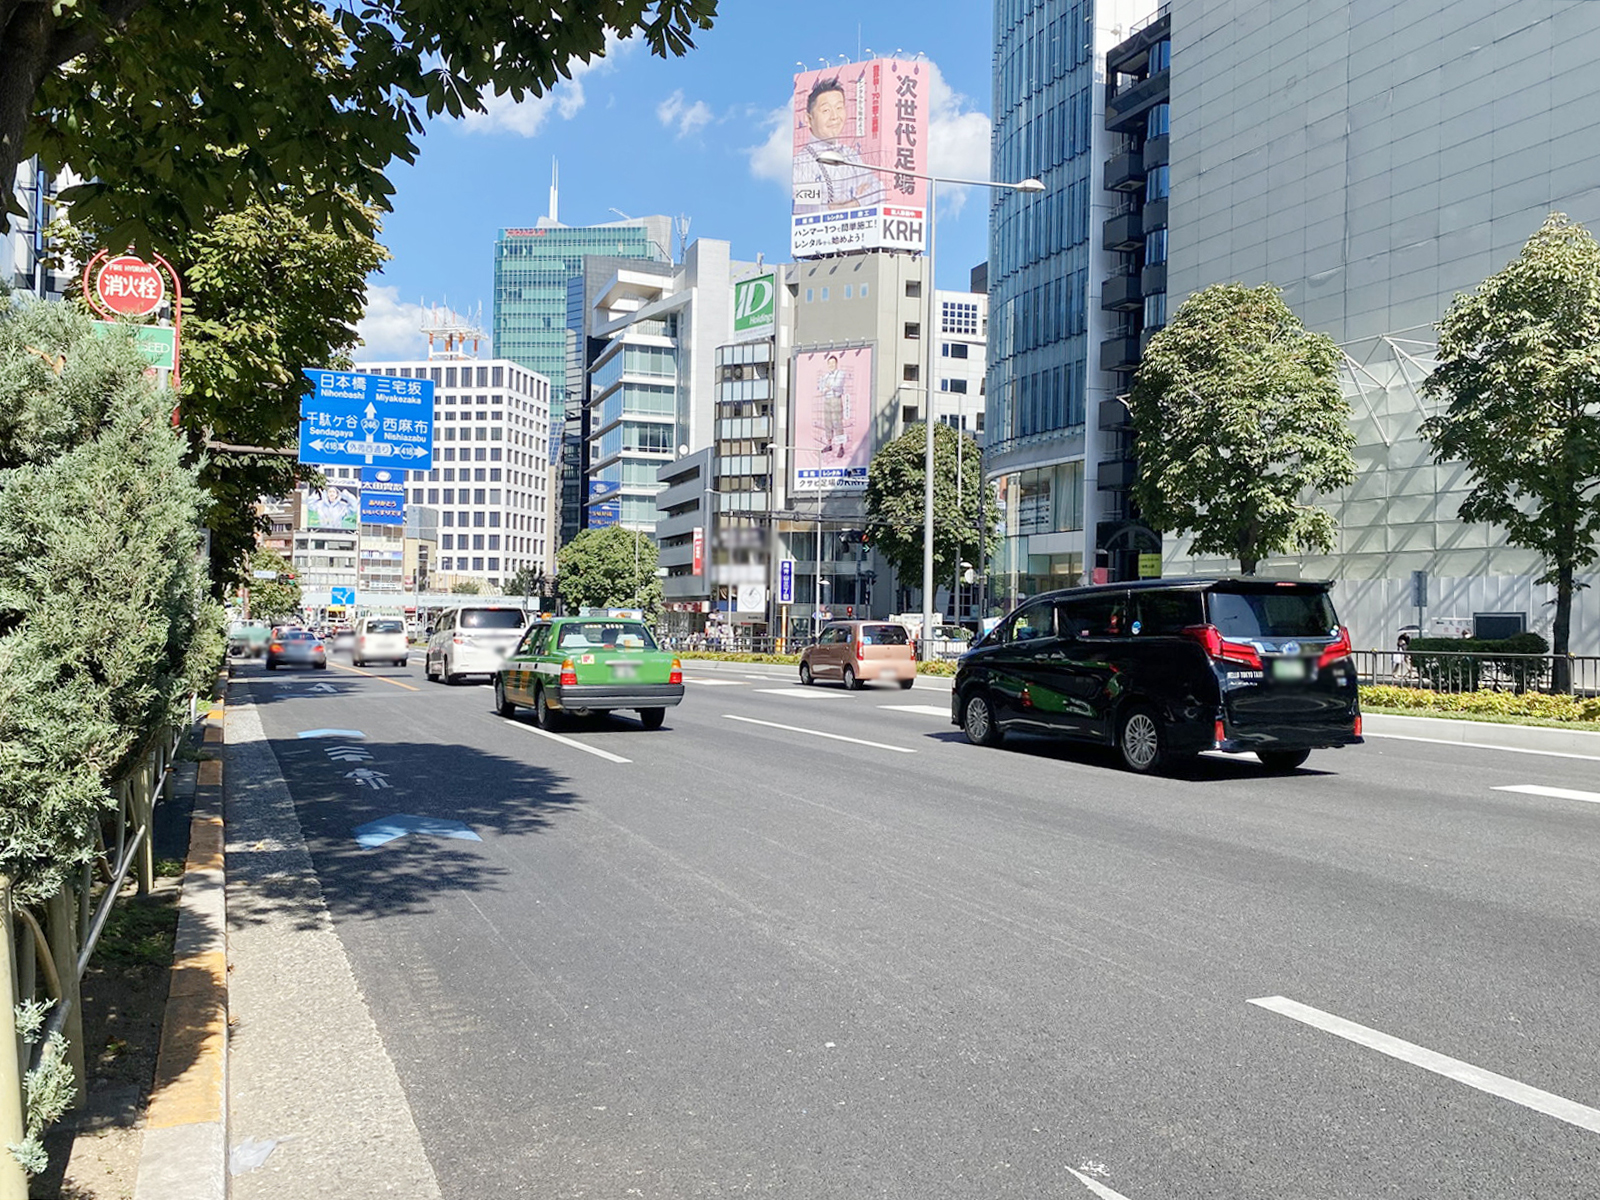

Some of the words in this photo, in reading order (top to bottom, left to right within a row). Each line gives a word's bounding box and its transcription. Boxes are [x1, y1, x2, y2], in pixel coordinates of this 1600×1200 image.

[894, 75, 918, 195] 次世代足場
[796, 189, 820, 199] KRH
[826, 213, 845, 222] レンタル
[883, 219, 922, 242] KRH
[104, 274, 158, 299] 消火栓
[736, 280, 773, 320] ID
[321, 373, 367, 391] 日本橋
[376, 379, 422, 396] 三宅坂
[321, 388, 365, 399] Nihonbashi
[376, 393, 422, 405] Miyakezaka
[362, 420, 377, 429] 246
[383, 417, 429, 434] 西麻布
[310, 426, 354, 438] Sendagaya
[384, 432, 427, 443] Nishiazabu
[324, 441, 338, 451] 418
[401, 447, 414, 456] 418
[823, 469, 842, 477] レンタル
